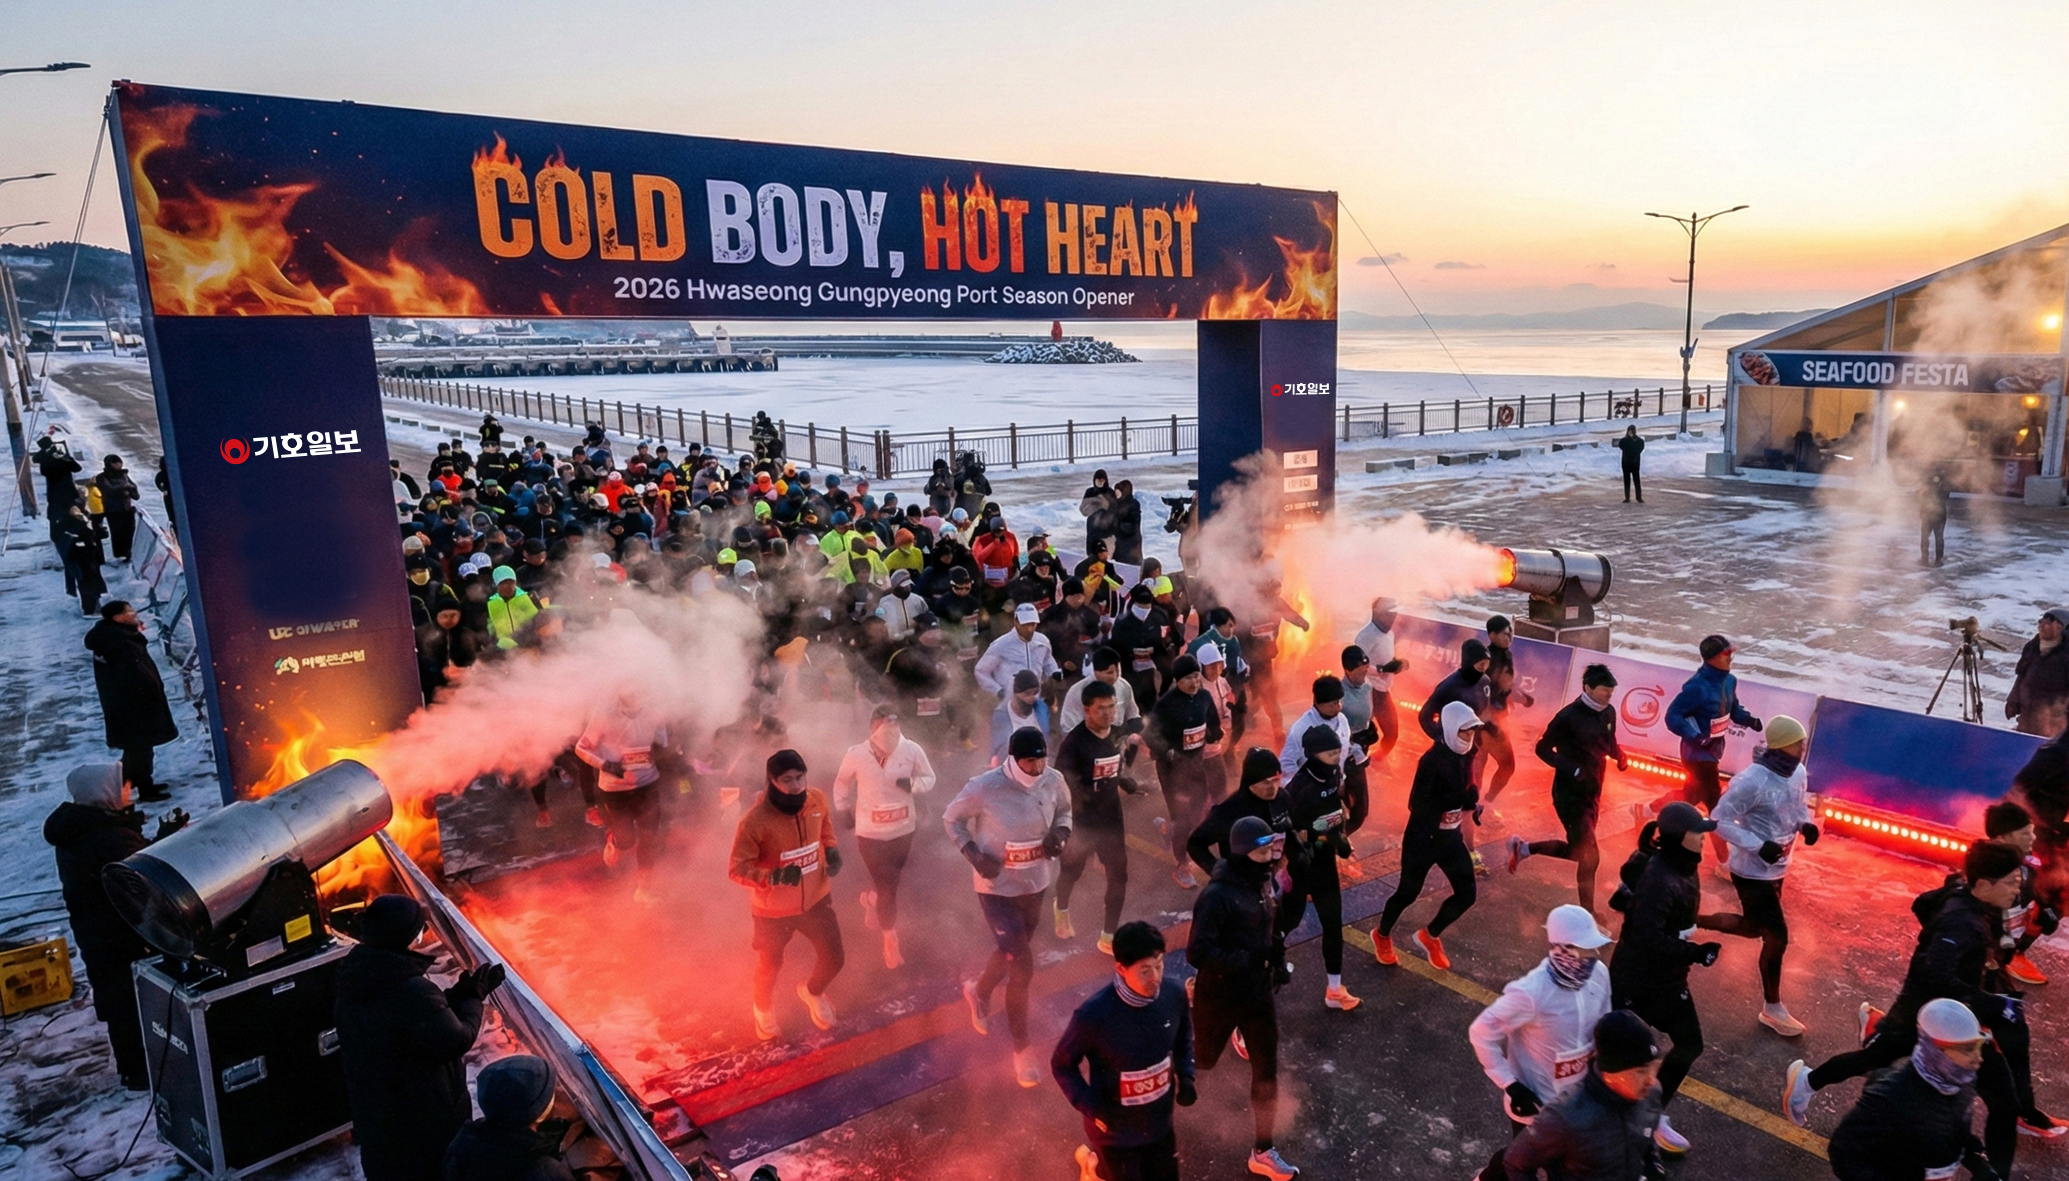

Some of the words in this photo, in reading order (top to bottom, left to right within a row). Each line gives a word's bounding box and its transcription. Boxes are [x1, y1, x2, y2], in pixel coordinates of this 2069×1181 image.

[472, 157, 686, 262] COLD
[706, 179, 904, 278] BODY,
[921, 188, 1029, 273] HOT
[1044, 200, 1198, 277] HEART
[613, 277, 680, 299] 2026
[687, 278, 811, 307] Hwaseong
[818, 282, 951, 309] Gungpyeong
[957, 284, 997, 304] Port
[1003, 286, 1068, 305] Season
[1073, 287, 1135, 310] Opener
[1802, 360, 1894, 384] SEAFOOD
[1901, 362, 1968, 386] FESTA
[1285, 383, 1330, 395] 기호일보
[253, 430, 362, 459] 기호일보
